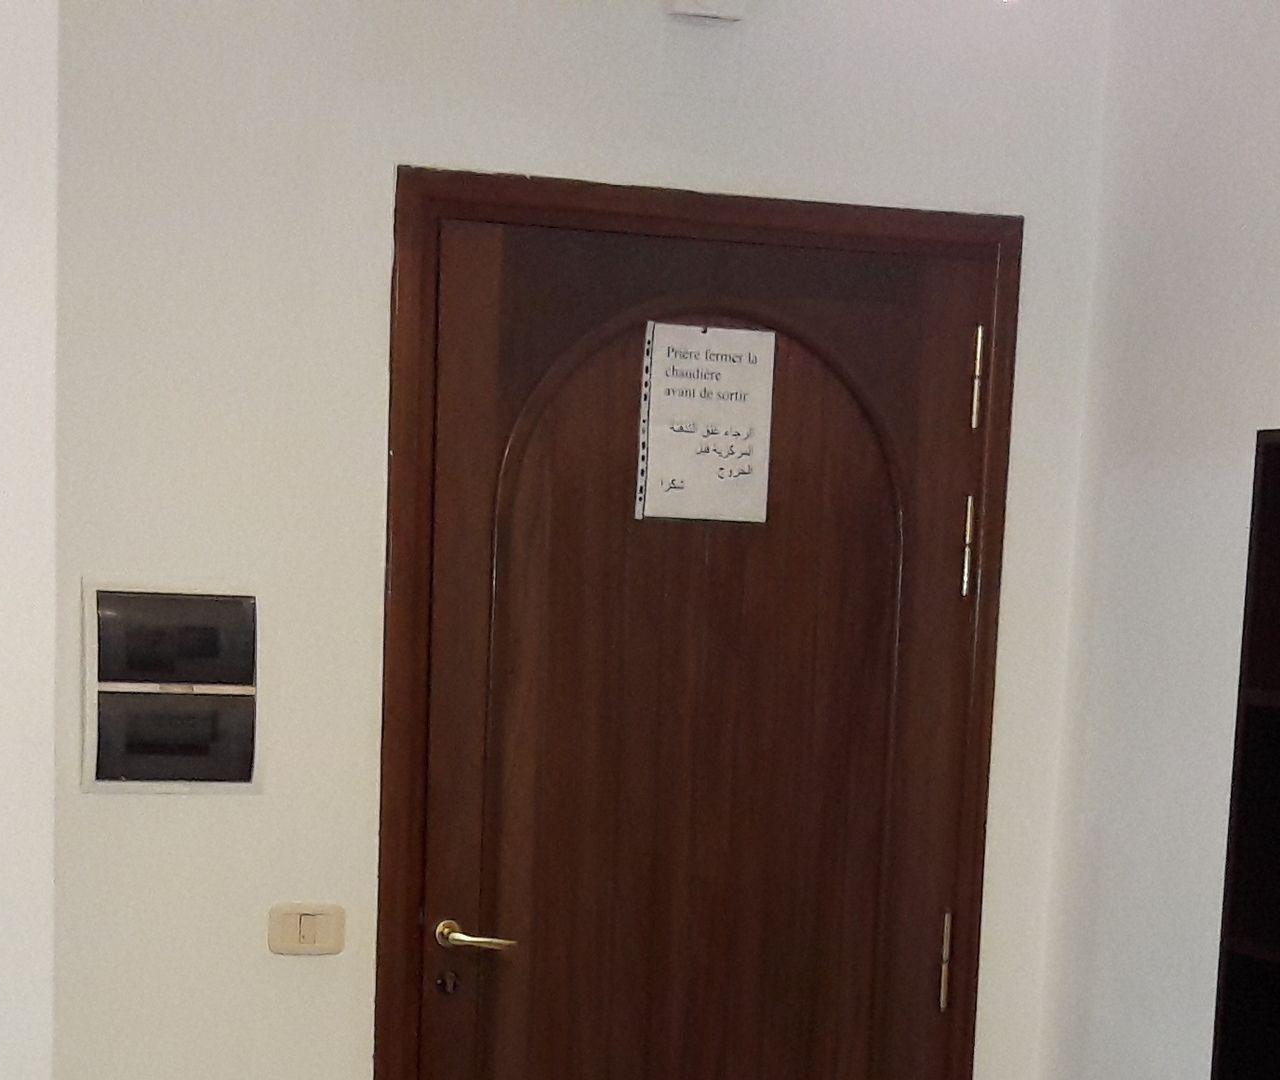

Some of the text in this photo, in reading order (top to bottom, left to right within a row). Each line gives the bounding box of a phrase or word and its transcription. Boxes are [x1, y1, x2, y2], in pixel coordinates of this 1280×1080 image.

[705, 348, 743, 364] fermer
[748, 352, 758, 365] la
[665, 387, 749, 402] avant de sortir
